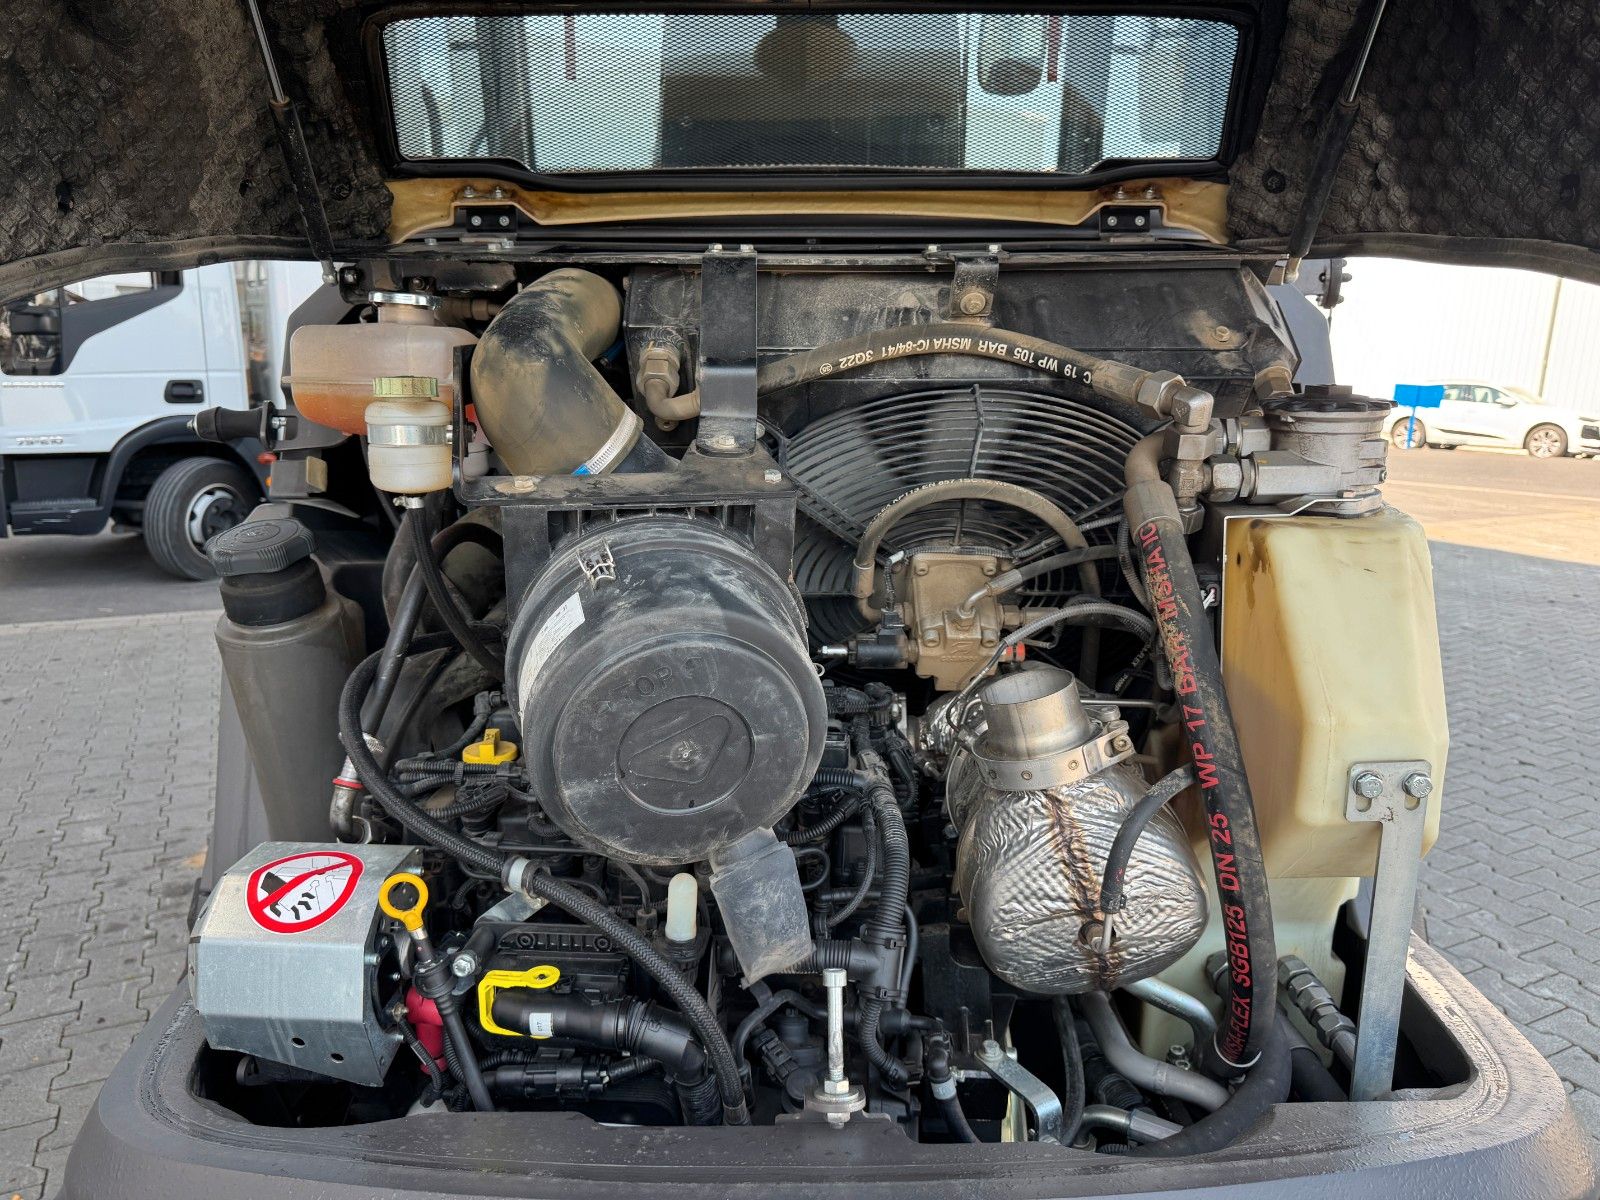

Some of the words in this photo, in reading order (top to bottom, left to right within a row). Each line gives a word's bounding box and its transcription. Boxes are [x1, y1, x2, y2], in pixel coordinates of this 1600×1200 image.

[881, 340, 930, 360] IC-84/41
[932, 337, 971, 352] MSHA
[978, 340, 1008, 357] BAR
[1013, 345, 1035, 362] 105
[839, 350, 874, 369] 3Q22
[1037, 355, 1060, 373] WP
[1063, 363, 1079, 378] 19
[1183, 705, 1207, 732] 17
[1193, 743, 1219, 790] WP
[1209, 812, 1230, 845] 25
[1216, 853, 1240, 892] DN
